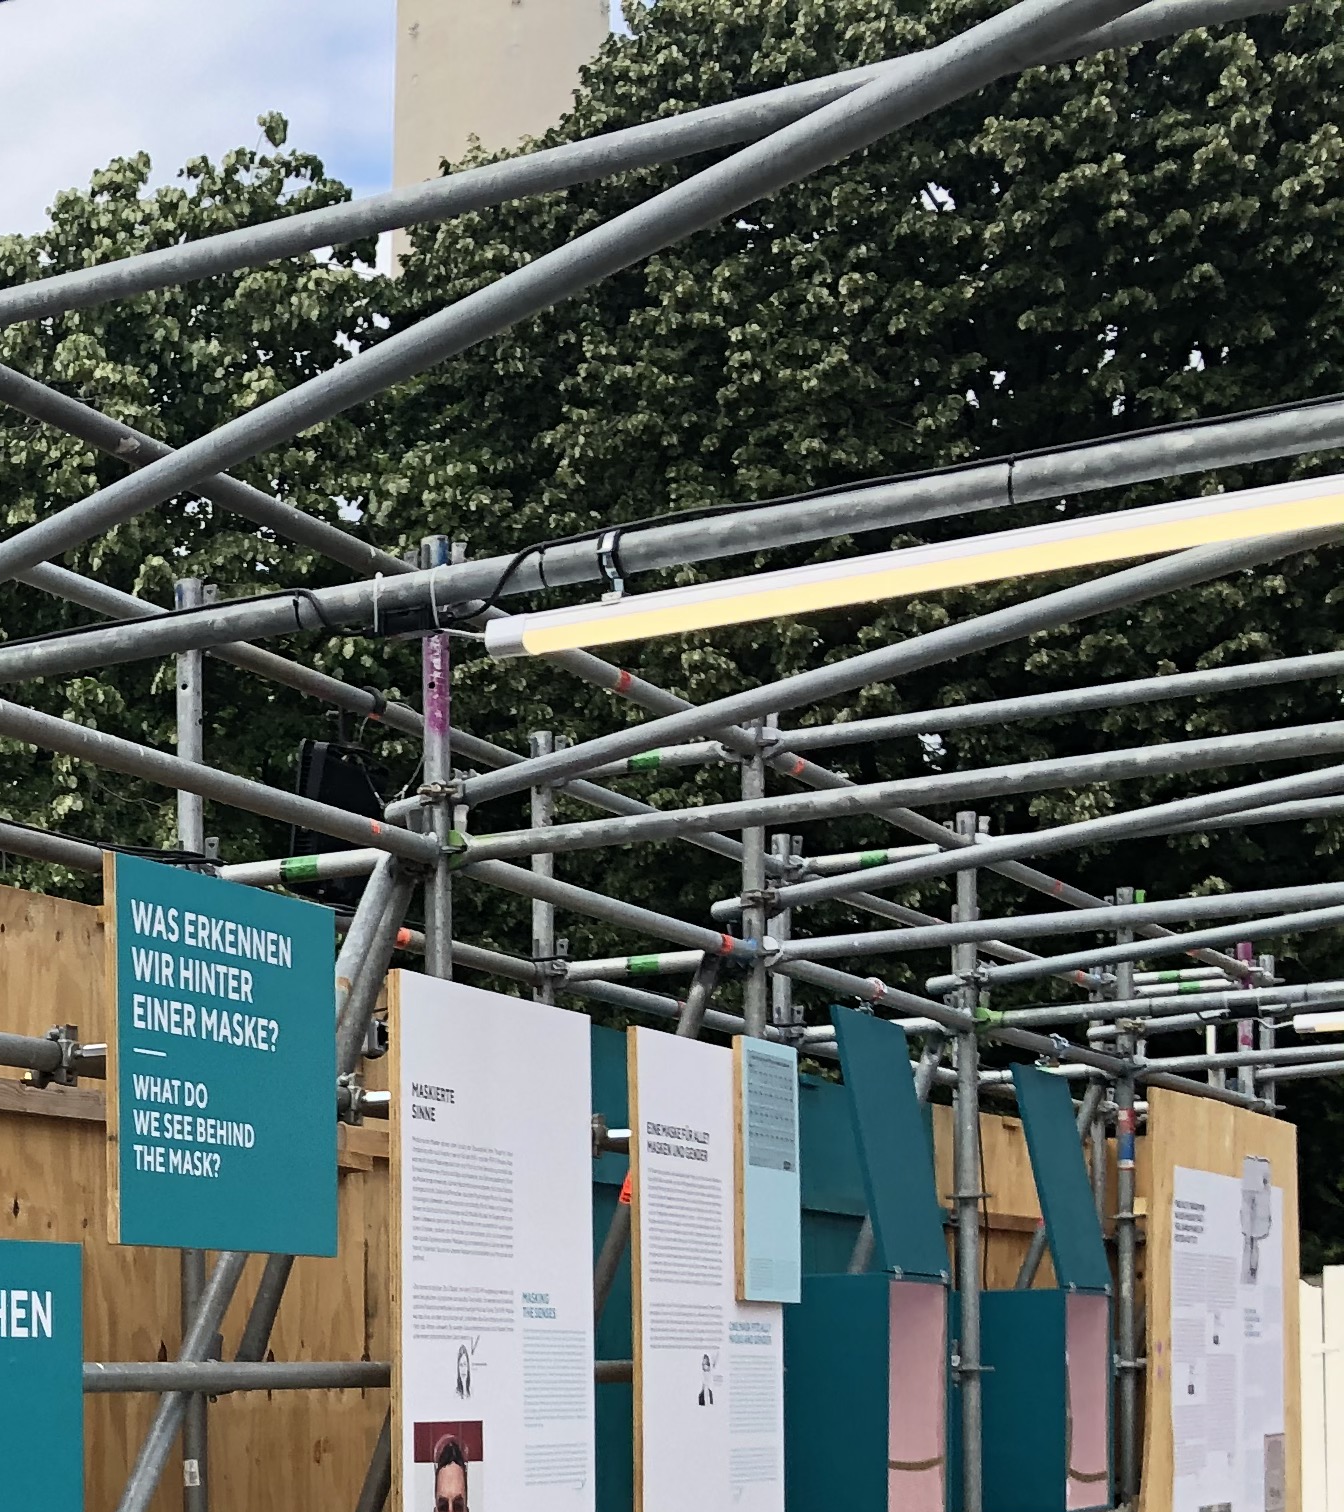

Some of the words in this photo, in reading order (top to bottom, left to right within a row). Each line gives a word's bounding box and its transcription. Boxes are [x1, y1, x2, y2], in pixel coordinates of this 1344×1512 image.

[131, 899, 179, 943] WAS
[185, 912, 292, 969] ERKENNEN
[132, 947, 174, 988] WIR
[179, 959, 253, 1004] HINTER
[133, 994, 196, 1038] EINER
[202, 1008, 279, 1052] MASKE?
[133, 1074, 181, 1107] WHAT
[184, 1082, 208, 1108] DO
[412, 1082, 455, 1104] MASKIERTE
[133, 1109, 161, 1137] WE
[164, 1113, 193, 1141] SEE
[197, 1119, 255, 1148] BEHIND
[412, 1104, 435, 1122] SINNE
[133, 1144, 165, 1173] THE
[169, 1149, 221, 1178] MASK?
